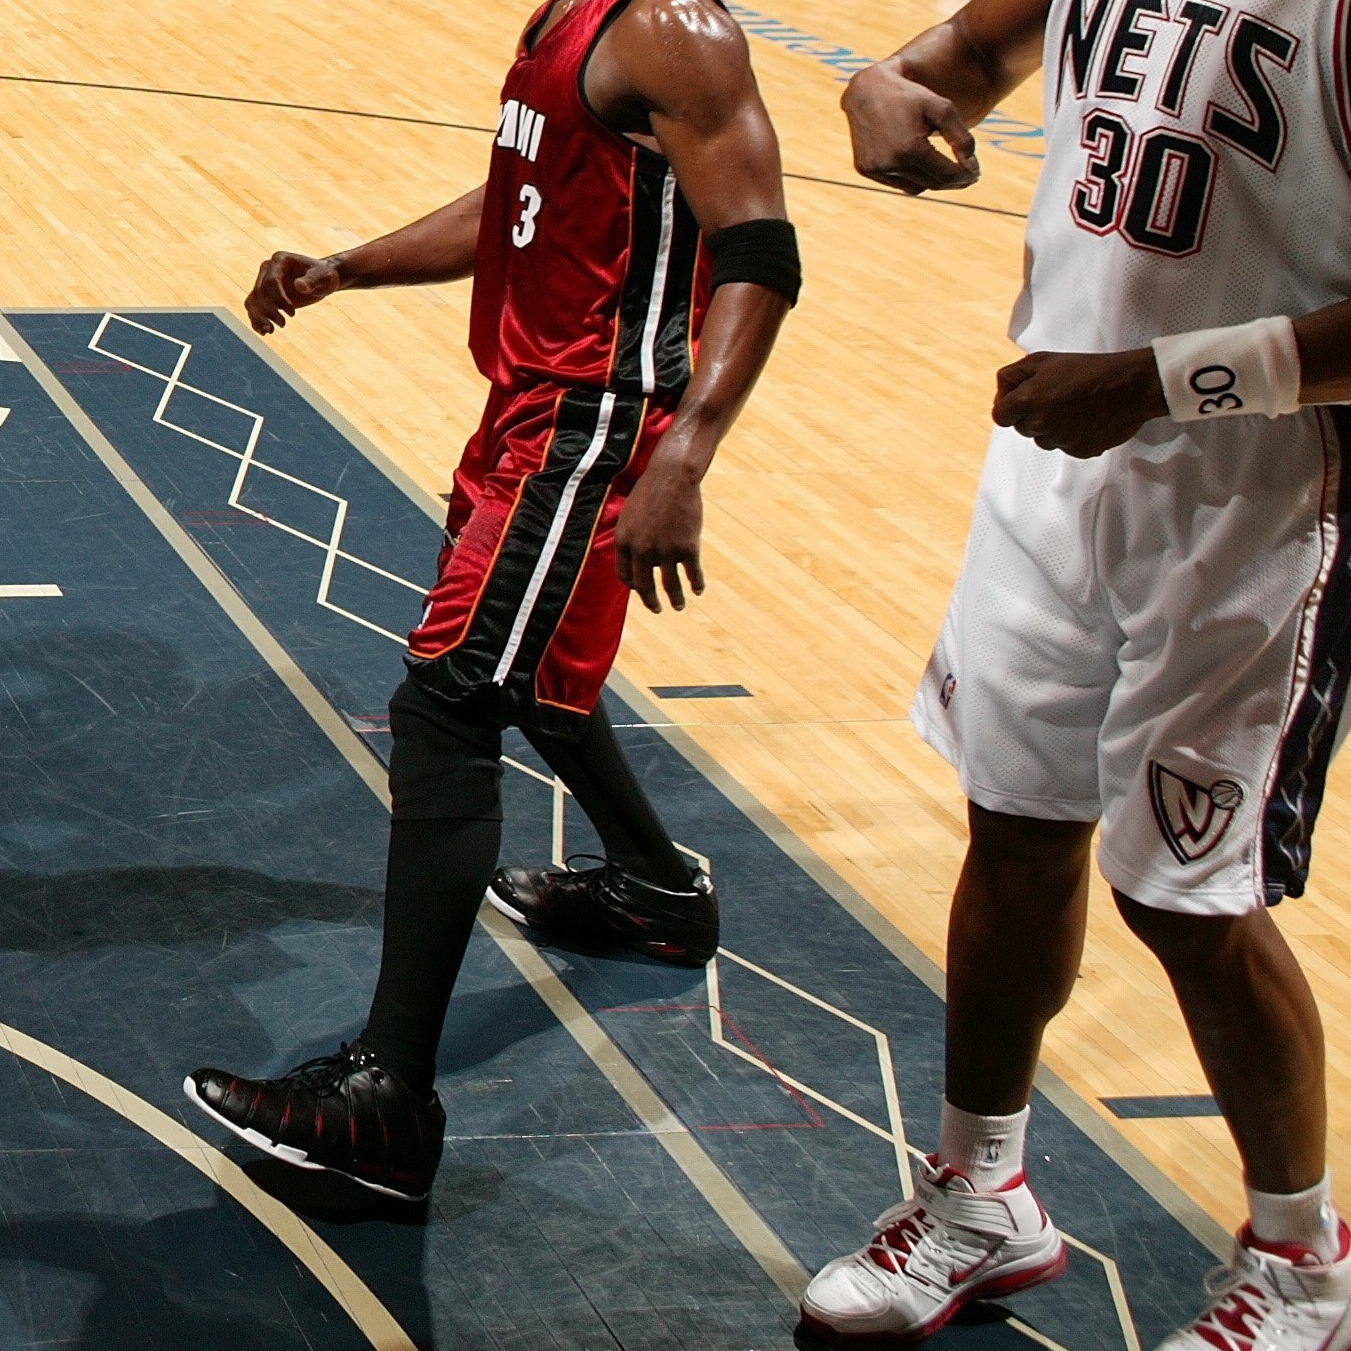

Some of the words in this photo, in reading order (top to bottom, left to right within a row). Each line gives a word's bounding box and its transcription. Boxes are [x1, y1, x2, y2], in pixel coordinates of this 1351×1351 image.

[511, 183, 542, 249] 3
[1069, 108, 1219, 259] 30
[1189, 363, 1243, 416] 30
